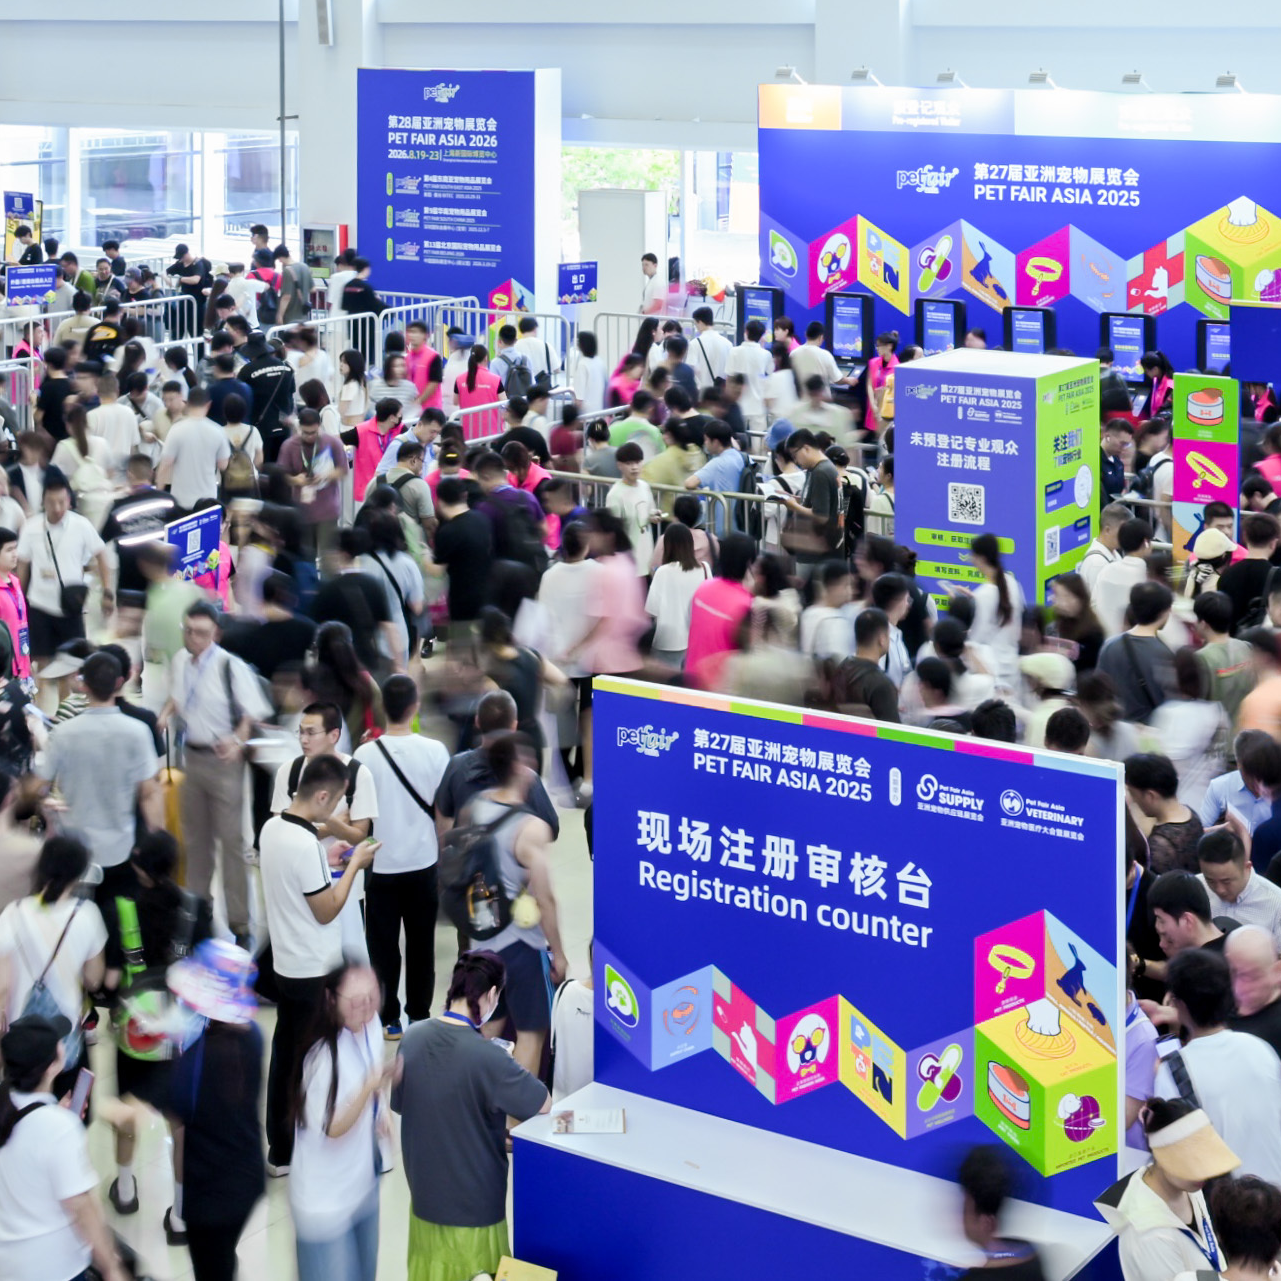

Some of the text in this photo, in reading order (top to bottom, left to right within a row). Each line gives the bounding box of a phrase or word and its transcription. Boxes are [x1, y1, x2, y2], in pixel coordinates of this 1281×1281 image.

[388, 115, 497, 131] 第28届亚洲宠物展览会
[388, 132, 497, 147] PET FAIR ASIA 2026
[973, 162, 1140, 187] 第27届亚洲宠物展览会
[973, 184, 1140, 208] PET FAIR ASIA 2025
[941, 384, 1022, 400] 第27届亚洲宠物展览会
[940, 394, 1022, 410] PET FAIR ASIA 2025
[910, 431, 1019, 455] 未预登记专业观众
[937, 452, 991, 471] 注册流程
[693, 728, 871, 779] 第27届亚洲宠物展览会
[693, 752, 872, 802] PET FAIR ASIA 2025
[939, 792, 984, 811] SUPPLY
[961, 788, 974, 796] Asia
[1037, 800, 1049, 809] Fair
[1051, 802, 1065, 811] Asia
[1026, 807, 1084, 827] VETERINARY
[637, 810, 933, 909] 现场注册审核台
[639, 860, 933, 948] Registration counter
